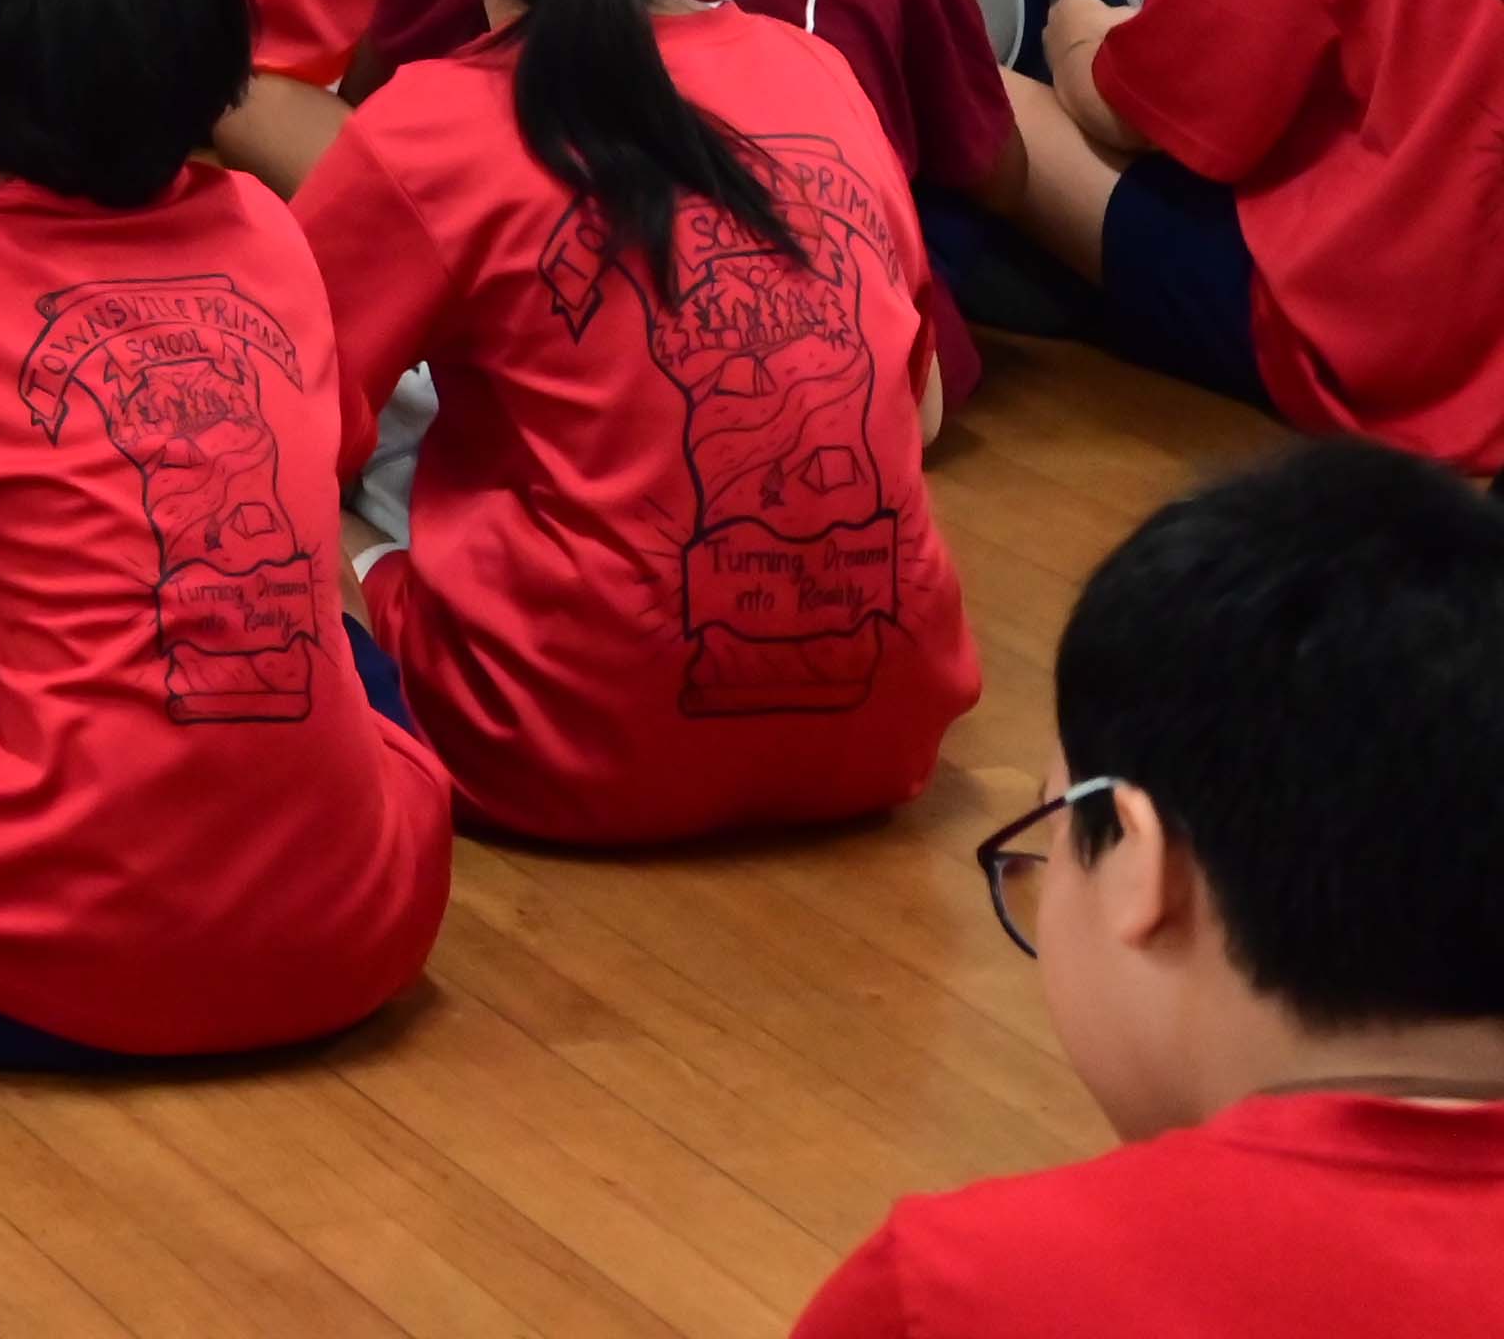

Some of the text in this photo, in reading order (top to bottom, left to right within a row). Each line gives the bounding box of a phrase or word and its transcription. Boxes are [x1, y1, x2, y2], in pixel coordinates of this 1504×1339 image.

[26, 295, 193, 399] TOWNSVILLE
[125, 330, 209, 366] SCHOOL
[704, 535, 805, 586] Turning
[168, 576, 246, 611] Turning
